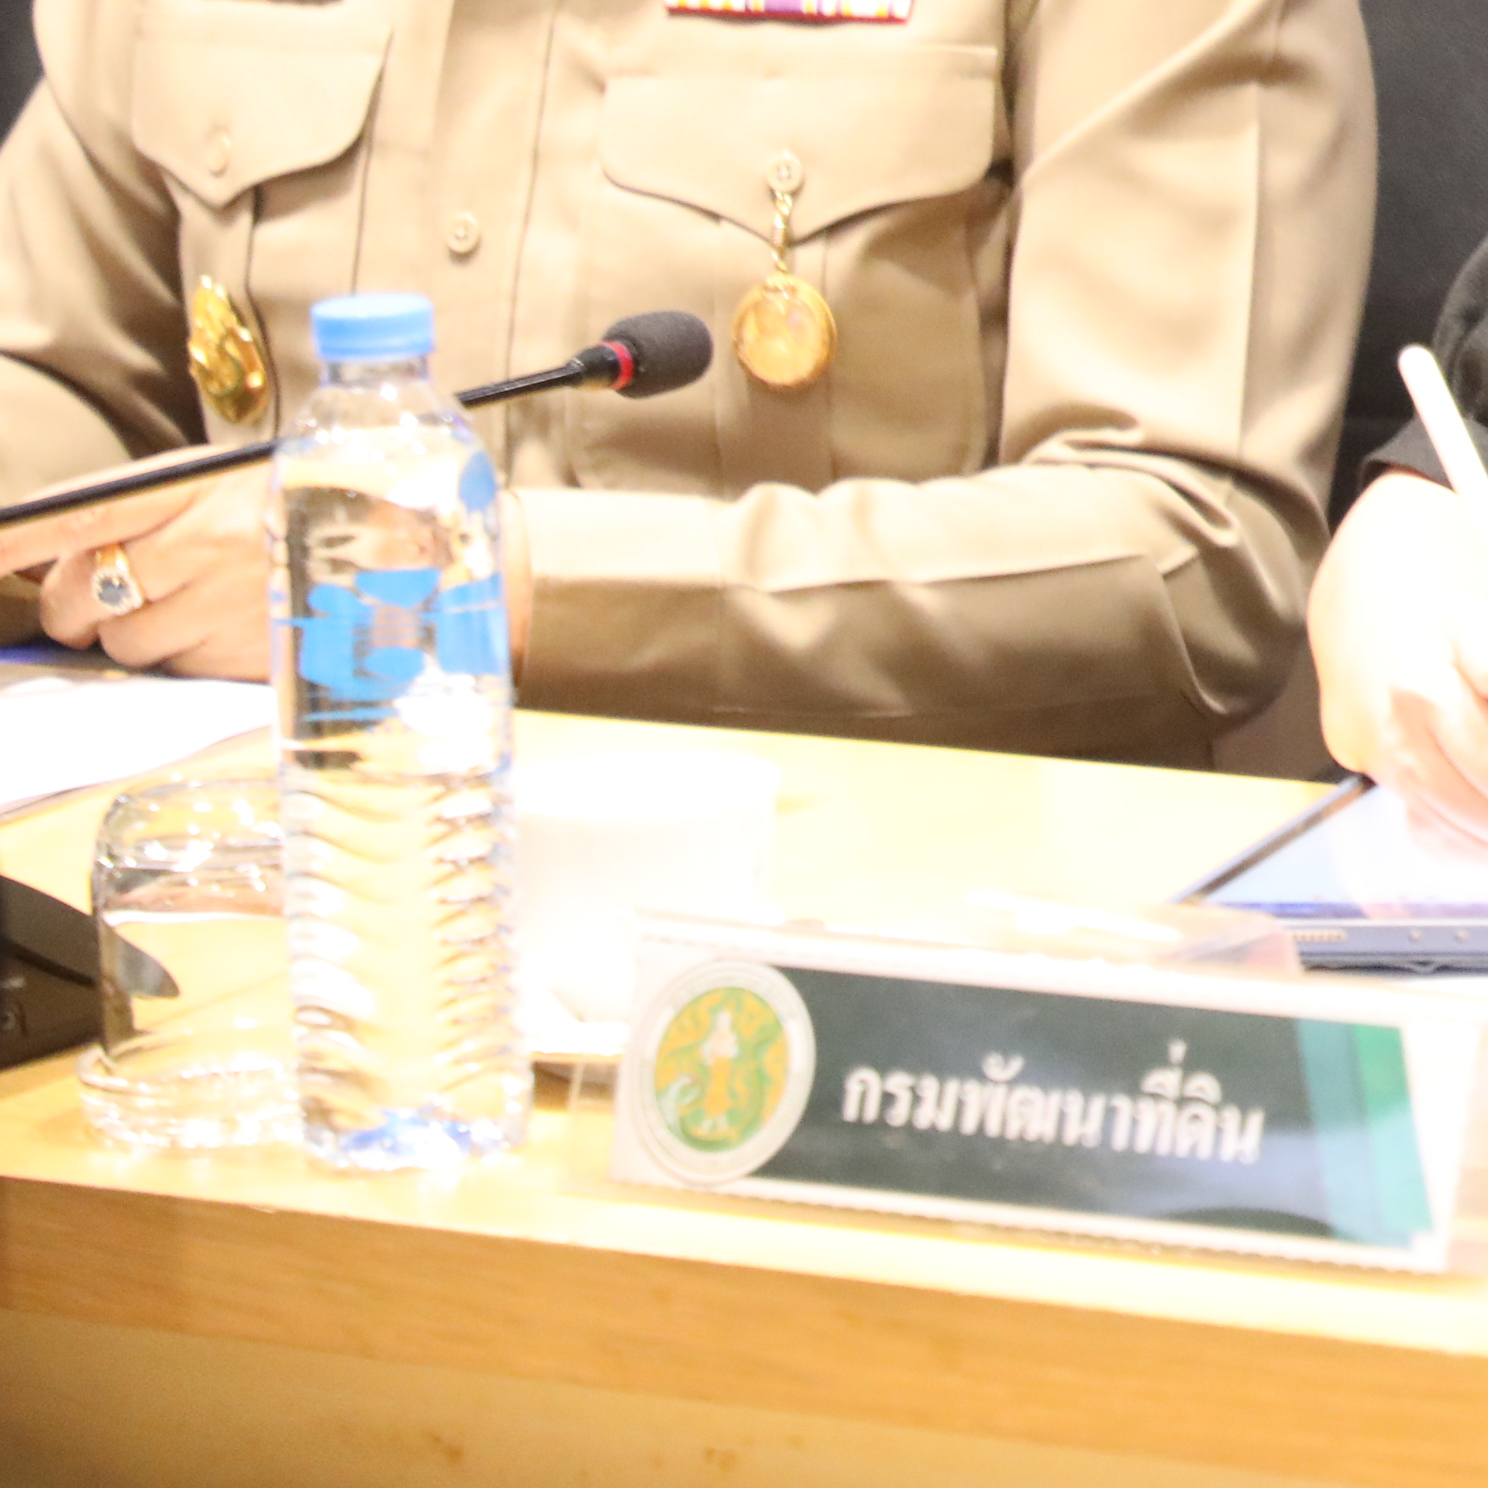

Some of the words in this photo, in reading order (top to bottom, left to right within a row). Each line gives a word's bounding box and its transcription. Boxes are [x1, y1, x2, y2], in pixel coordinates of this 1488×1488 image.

[842, 1038, 1266, 1165] กรมพัฒนาที่ดิน
